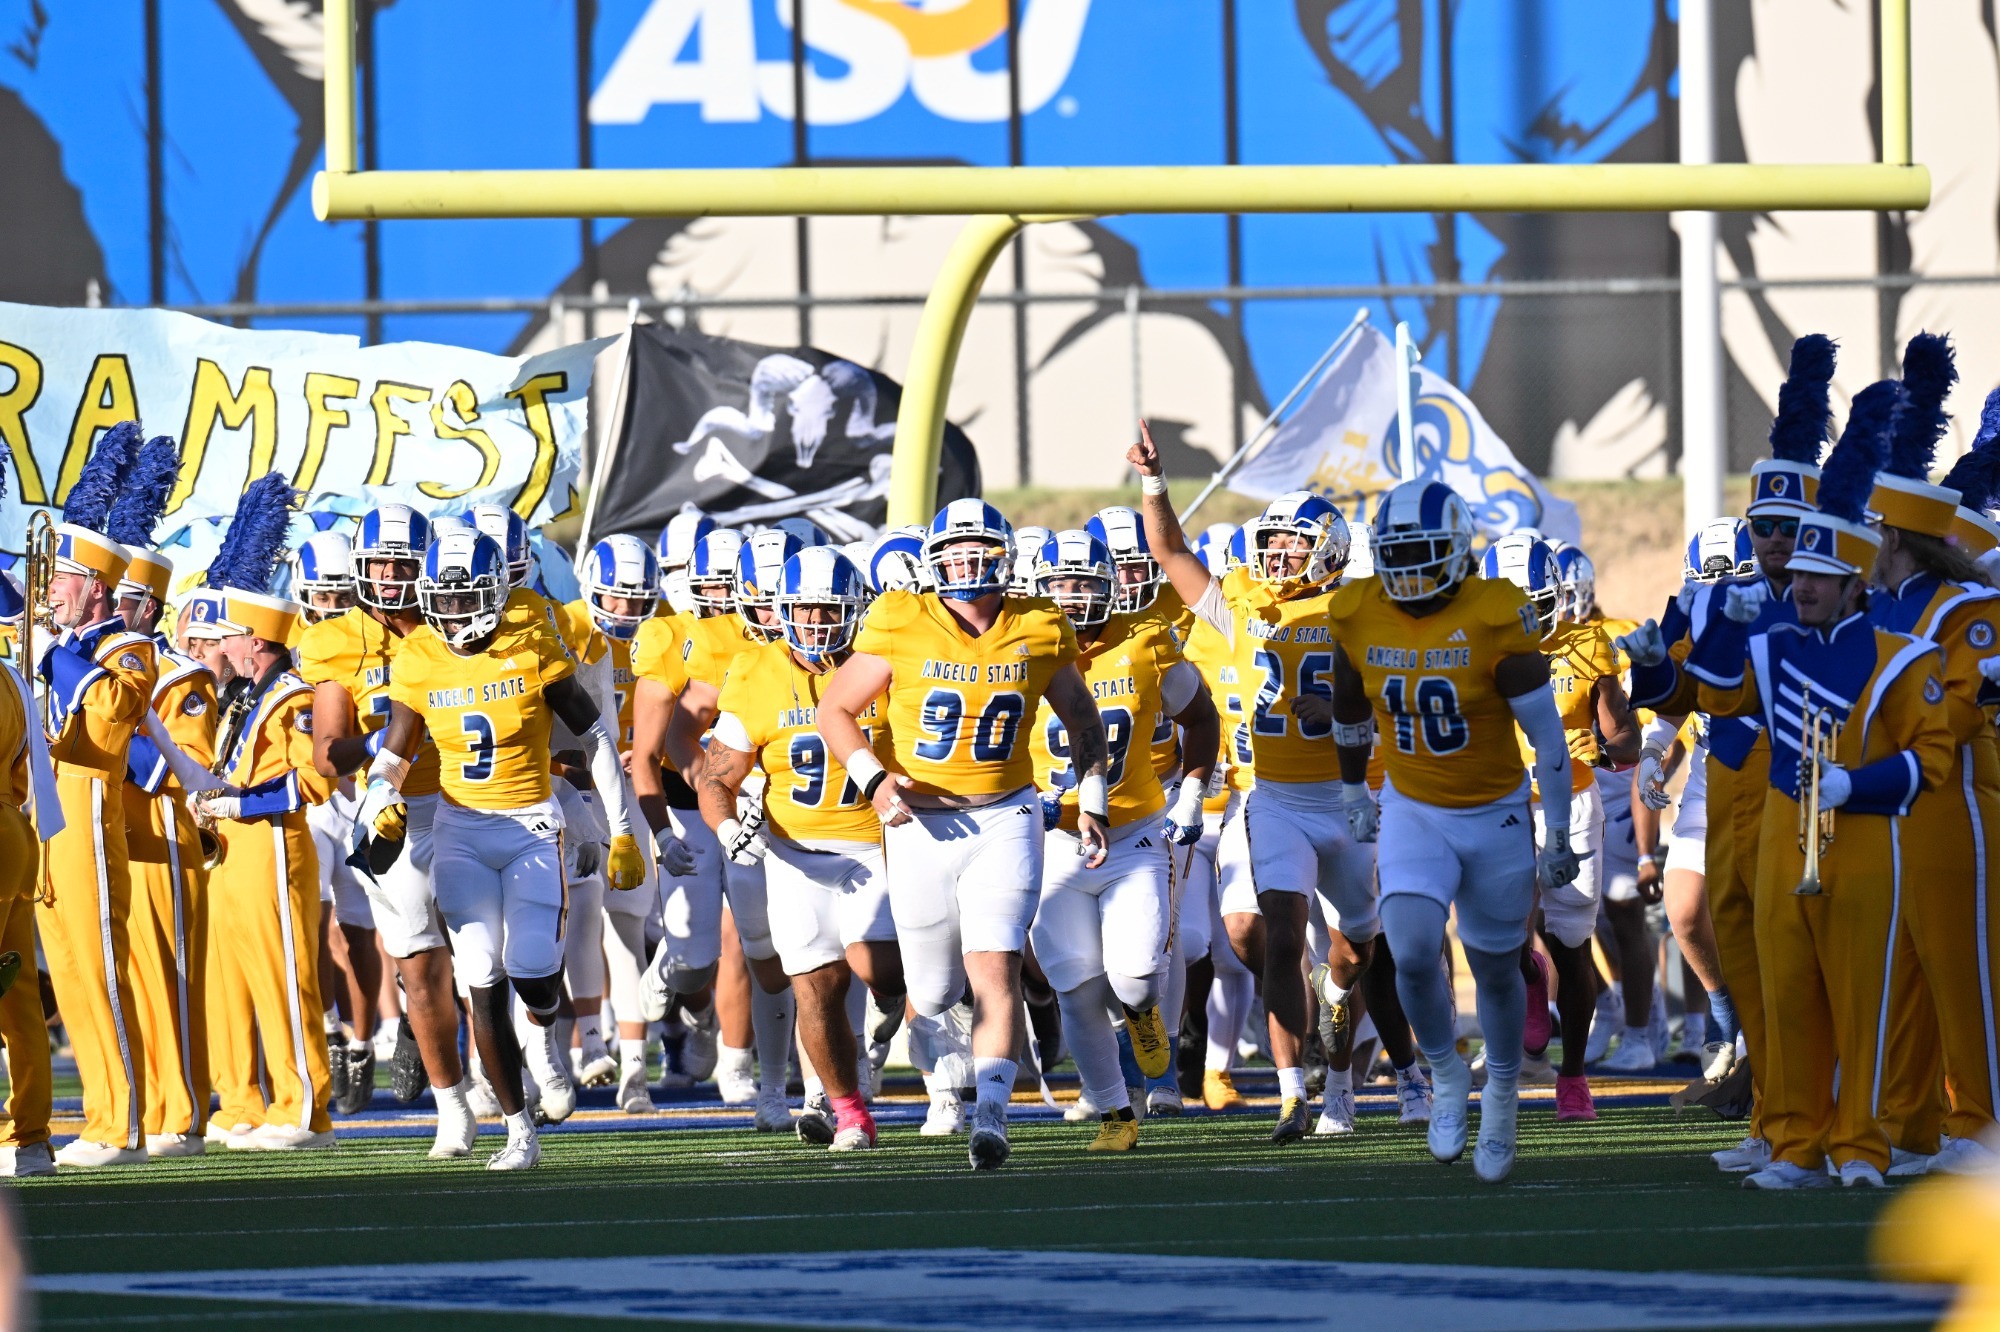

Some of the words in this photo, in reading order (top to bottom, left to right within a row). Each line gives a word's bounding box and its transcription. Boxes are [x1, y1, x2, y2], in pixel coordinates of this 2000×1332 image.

[588, 0, 1093, 126] ASU
[1246, 618, 1291, 643] ANGELO
[1366, 645, 1418, 670] ANGELO
[1424, 646, 1471, 670] STATE
[921, 658, 979, 684] ANGELO
[986, 661, 1028, 684] STATE
[428, 686, 475, 709] ANGELO
[483, 676, 526, 703] STATE
[1093, 676, 1135, 700] STATE
[1551, 675, 1574, 694] ATE
[778, 705, 818, 729] ANGEL
[911, 686, 1026, 764] 90
[461, 710, 497, 783] 3
